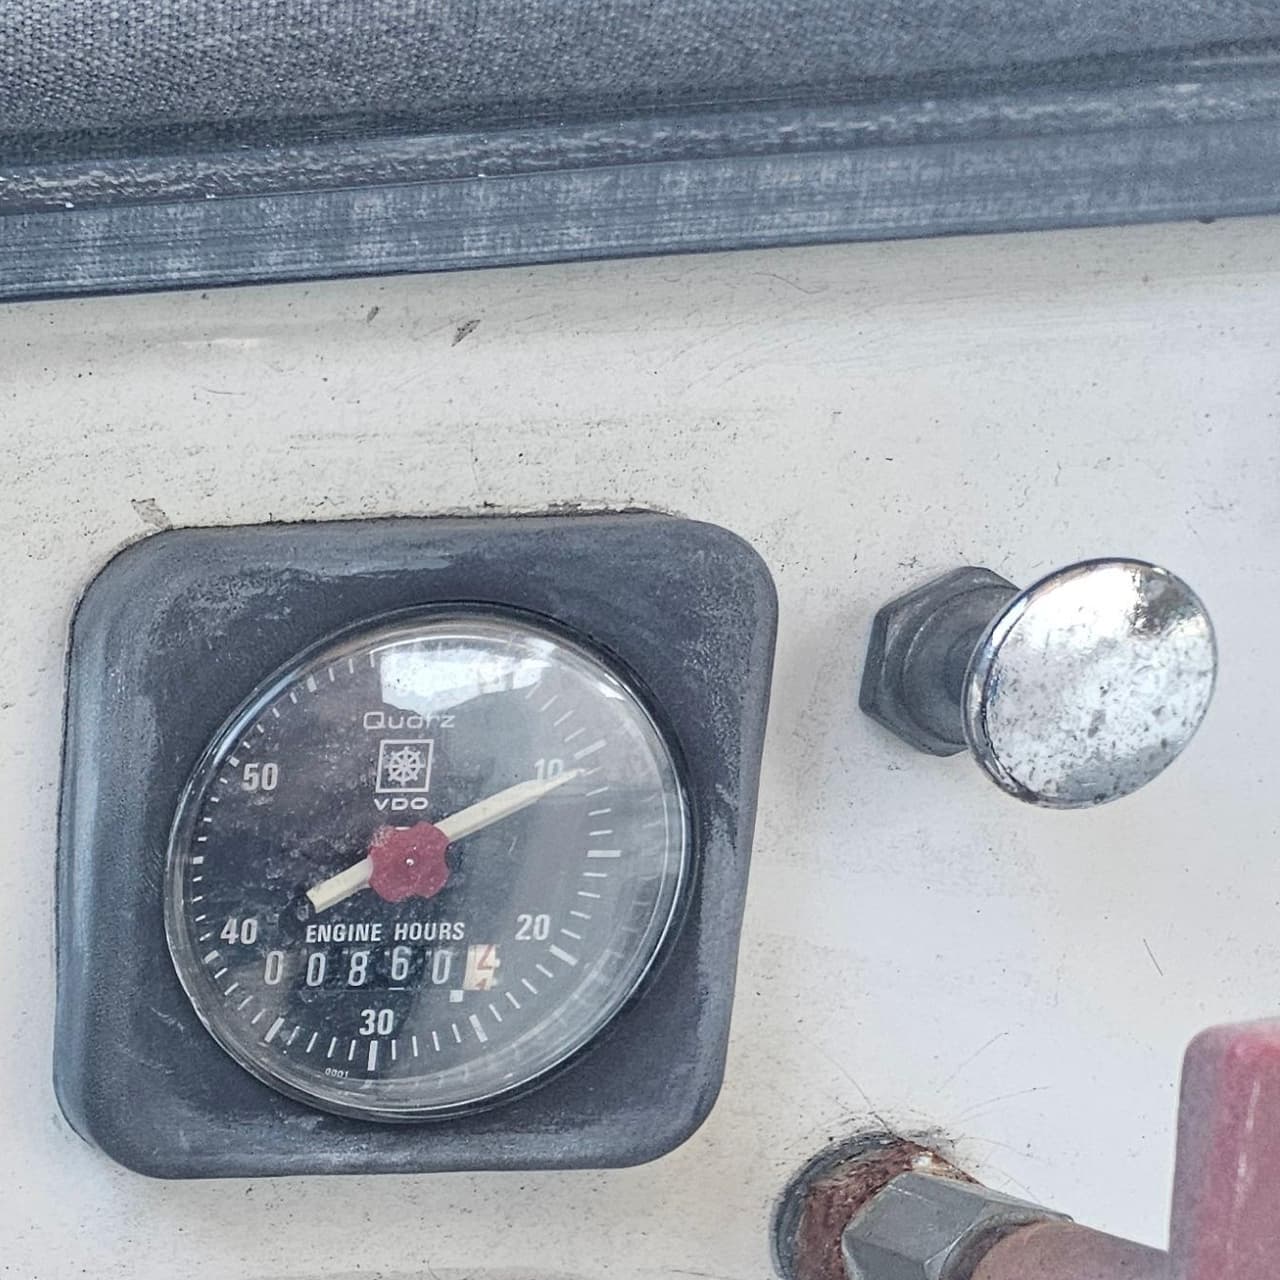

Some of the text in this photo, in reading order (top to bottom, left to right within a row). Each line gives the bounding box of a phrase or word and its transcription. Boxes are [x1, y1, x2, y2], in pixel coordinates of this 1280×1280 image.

[242, 762, 279, 791] 50
[534, 758, 564, 782] 10
[373, 797, 429, 811] VDO
[220, 918, 258, 945] 40
[305, 922, 465, 943] ENGINE HOURS
[515, 913, 550, 941] 20
[359, 1008, 394, 1035] 30
